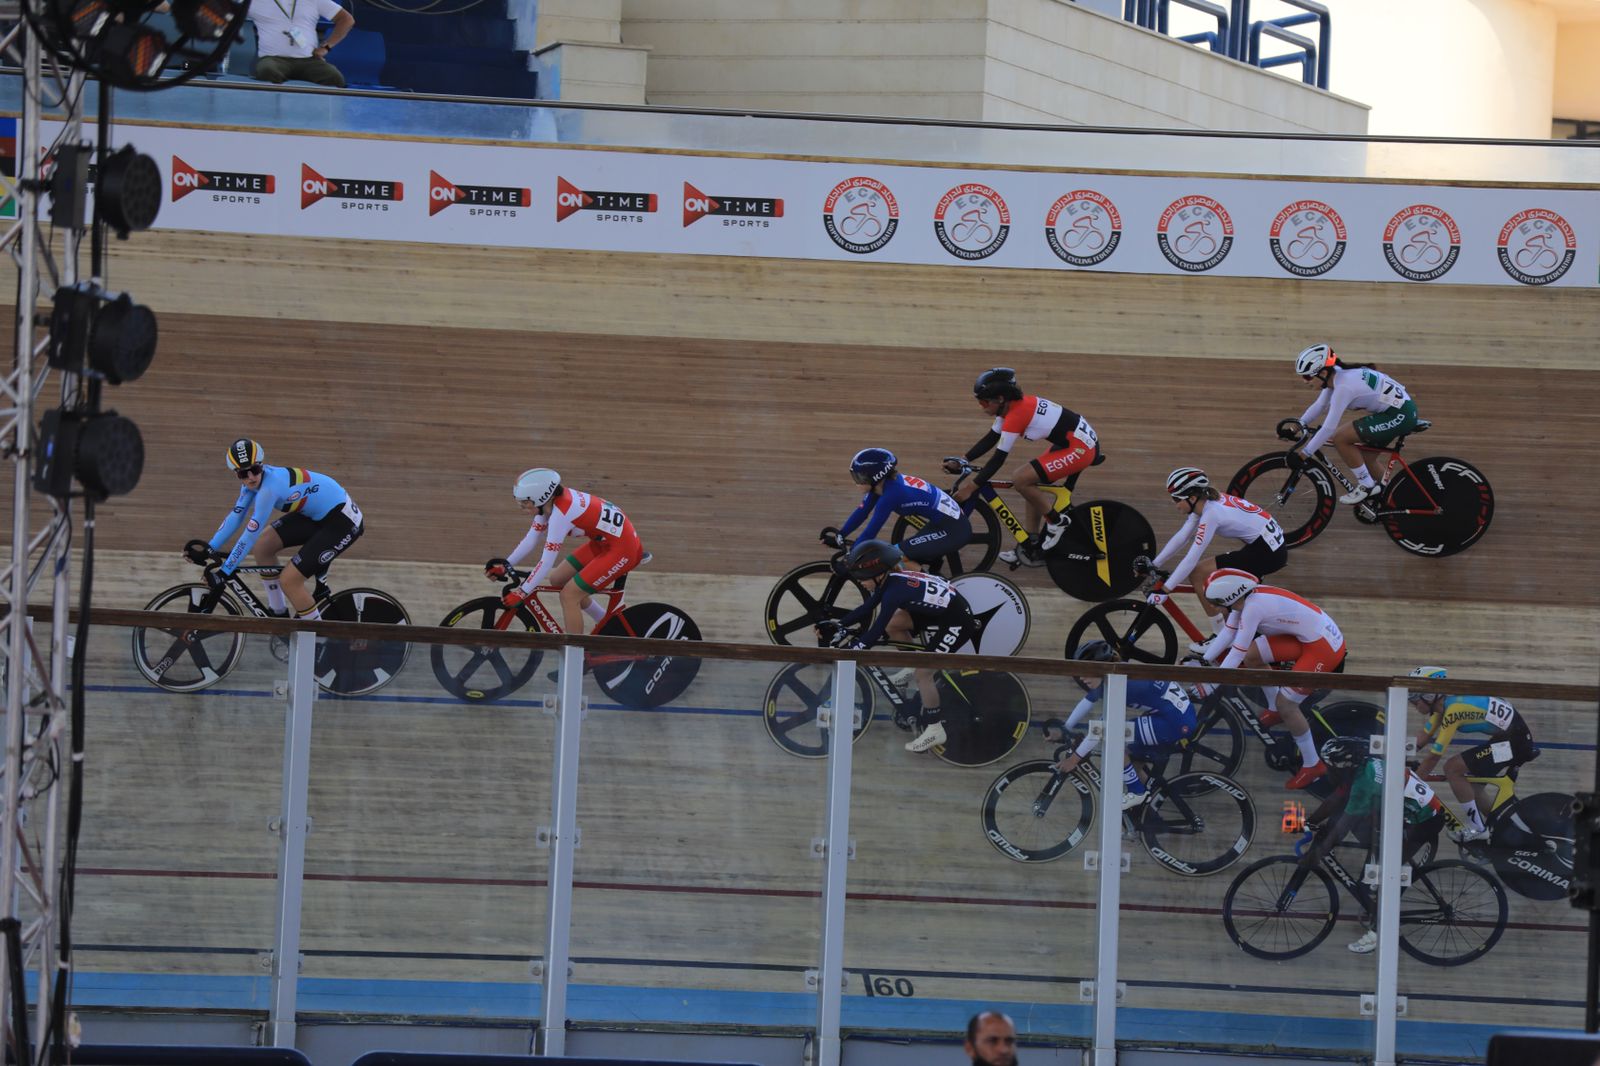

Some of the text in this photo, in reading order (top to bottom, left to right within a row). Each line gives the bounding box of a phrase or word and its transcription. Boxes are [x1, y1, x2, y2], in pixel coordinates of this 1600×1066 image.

[174, 172, 199, 187] ON
[302, 180, 328, 194] ON
[212, 194, 261, 204] SPORTS
[431, 187, 456, 202] ON
[558, 193, 582, 208] ON
[844, 188, 880, 202] ECF
[955, 194, 992, 209] ECF
[341, 202, 390, 212] SPORTS
[469, 208, 518, 218] SPORTS
[684, 198, 709, 212] ON
[1066, 201, 1103, 215] ECF
[1178, 206, 1215, 221] ECF
[596, 214, 644, 223] SPORTS
[722, 219, 770, 228] SPORTS
[1291, 211, 1328, 226] ECF
[1405, 216, 1442, 230] ECF
[1519, 220, 1557, 234] ECF
[826, 220, 896, 251] EGYPTIAN CYCLING FEDERATION
[937, 227, 1007, 258] EGYPTIAN CYCLING FEDERATION
[1048, 233, 1119, 263] EGYPTIAN CYCLING FEDERATION
[1160, 239, 1231, 269] EGYPTIAN CYCLING FEDERATION
[1273, 244, 1344, 274] EGYPTIAN CYCLING FEDERATION
[1386, 249, 1458, 279] EGYPTIAN CYCLING FEDERATION
[1500, 252, 1573, 283] EGYPTIAN CYCLING FEDERATION
[1370, 413, 1406, 434] MEXICO
[1045, 449, 1081, 473] EGYPT
[872, 462, 892, 481] KASK
[539, 481, 556, 503] KASK
[602, 508, 625, 527] 10
[998, 505, 1020, 535] LOOK
[1094, 510, 1104, 542] MAVIC
[1265, 519, 1284, 545] 51
[334, 534, 352, 550] lotto
[592, 556, 628, 588] BELARUS
[926, 581, 948, 598] 57
[994, 583, 1022, 615] GHIBLI
[1224, 583, 1248, 603] KASK
[936, 626, 962, 654] USA
[1440, 711, 1486, 729] KAZAKHSTA
[1490, 700, 1512, 721] 167
[1230, 697, 1276, 746] FUJI
[1416, 782, 1426, 796] 6
[1508, 857, 1570, 890] CORIMA
